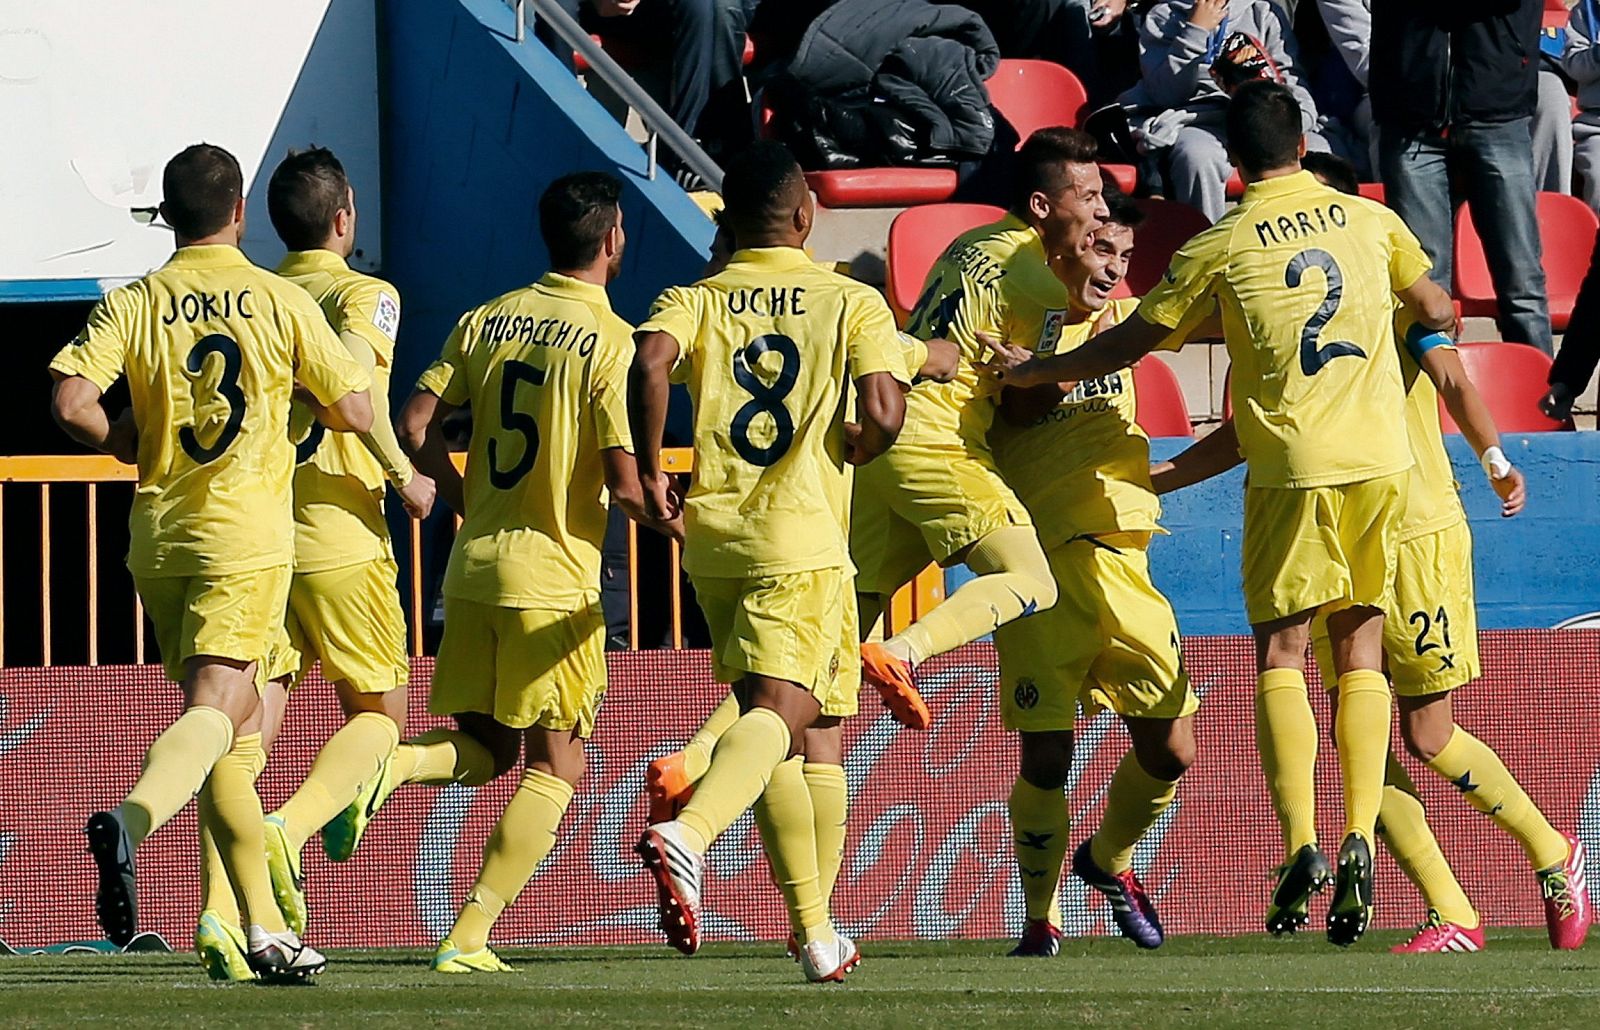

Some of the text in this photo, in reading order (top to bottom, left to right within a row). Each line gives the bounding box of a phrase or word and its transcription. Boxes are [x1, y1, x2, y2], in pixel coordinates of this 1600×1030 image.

[1255, 204, 1347, 247] MARIO
[481, 315, 597, 357] MUSACCHIO
[728, 287, 806, 317] UCHE
[1285, 249, 1367, 376] 2
[179, 334, 246, 464] 3
[488, 360, 546, 490] 5
[730, 334, 800, 466] 8
[1409, 606, 1451, 656] 21
